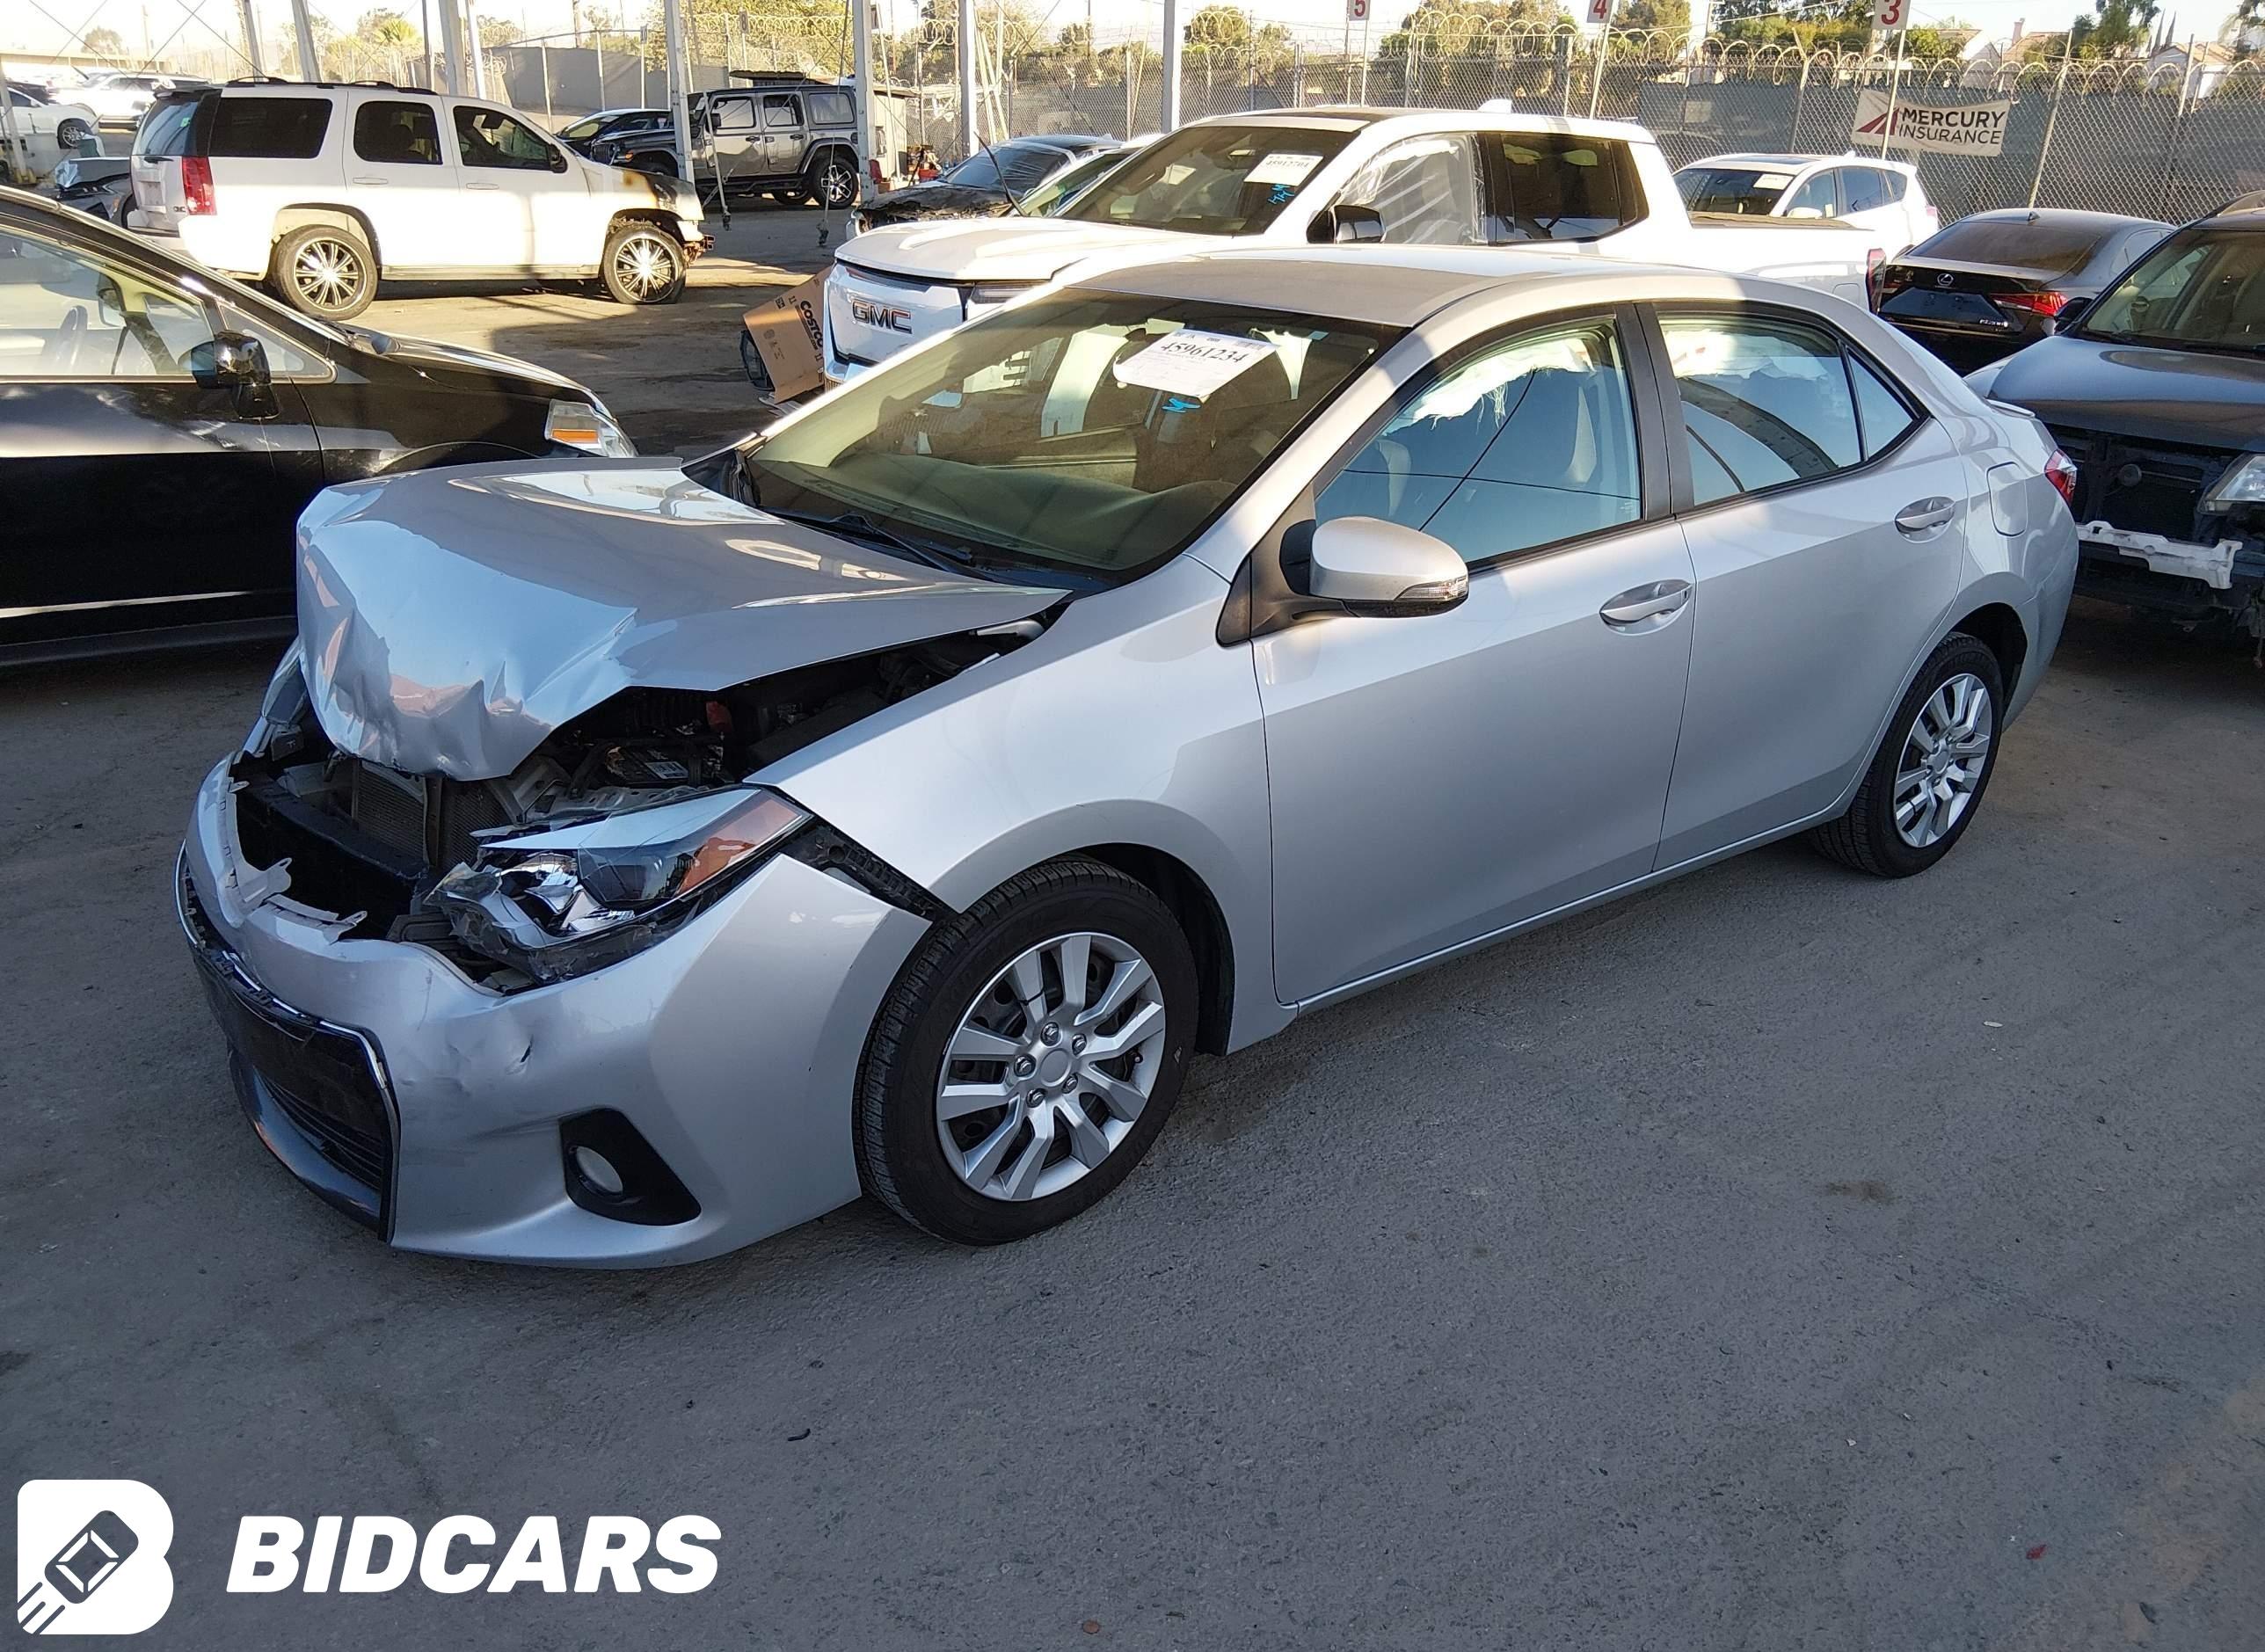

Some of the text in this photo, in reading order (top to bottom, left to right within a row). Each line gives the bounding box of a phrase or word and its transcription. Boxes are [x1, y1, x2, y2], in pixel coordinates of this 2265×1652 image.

[1354, 0, 1366, 17] 5
[1593, 0, 1607, 19] 4
[1881, 0, 1902, 25] 3
[741, 13, 747, 31] 8
[1901, 106, 2006, 128] MERCURY
[1898, 123, 2002, 145] INSURANCE
[800, 300, 824, 348] COSTCO
[851, 298, 913, 335] GMC
[1161, 341, 1249, 363] 45961234
